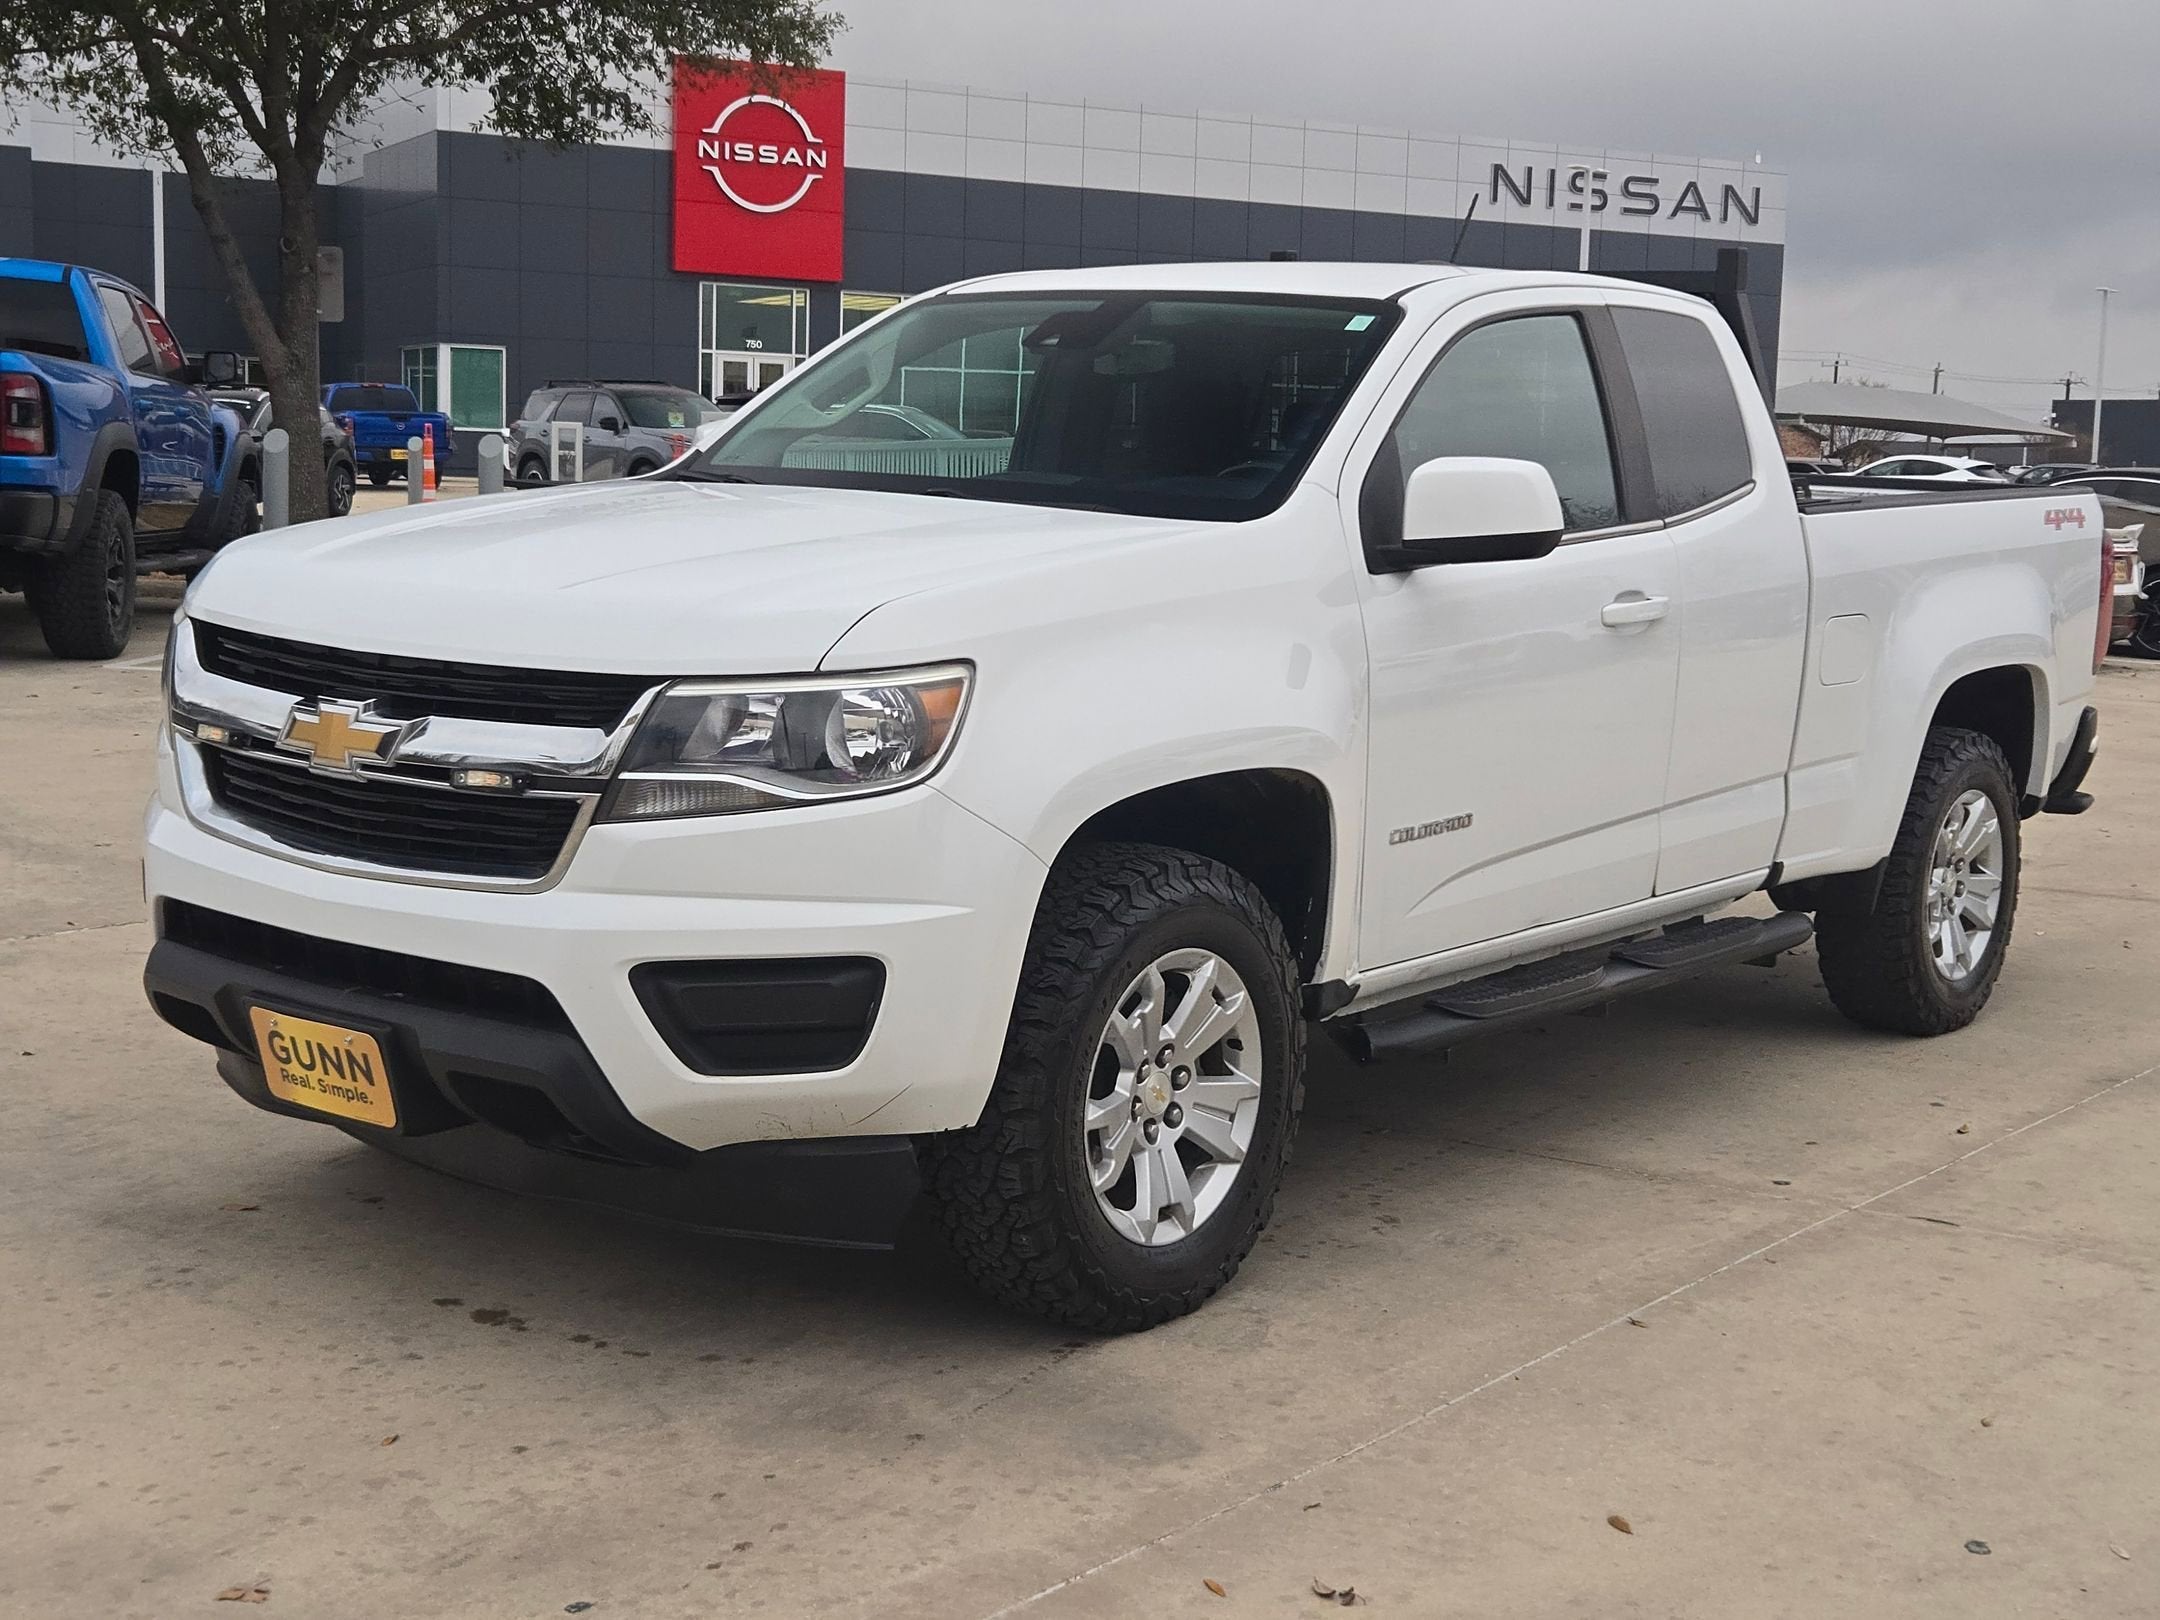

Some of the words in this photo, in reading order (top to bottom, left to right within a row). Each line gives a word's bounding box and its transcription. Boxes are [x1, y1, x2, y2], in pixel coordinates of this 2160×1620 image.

[698, 138, 828, 169] NISSAN
[1490, 163, 1760, 226] NISSAN
[745, 339, 763, 349] 750
[1388, 812, 1473, 846] COLORADO
[268, 1030, 375, 1087] GUNN
[280, 1067, 315, 1091] Real.
[318, 1078, 374, 1106] Simple.
